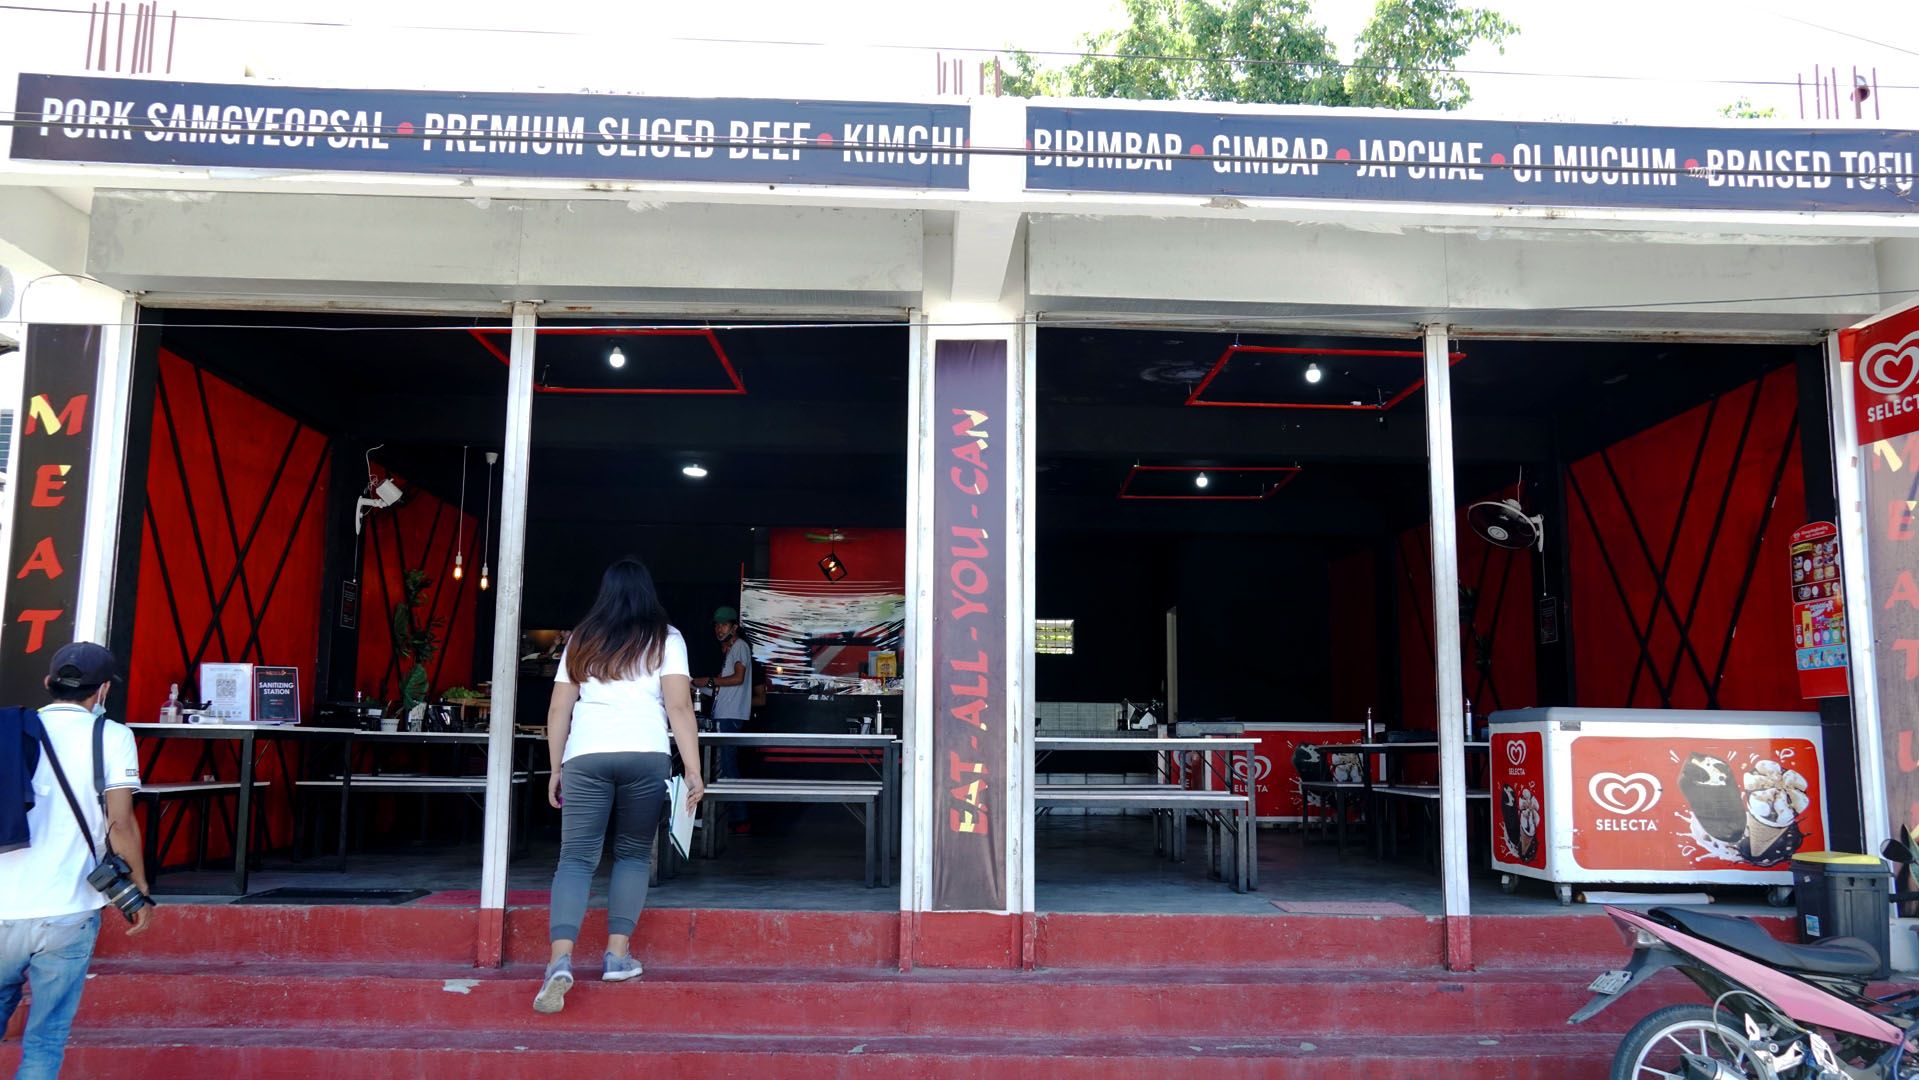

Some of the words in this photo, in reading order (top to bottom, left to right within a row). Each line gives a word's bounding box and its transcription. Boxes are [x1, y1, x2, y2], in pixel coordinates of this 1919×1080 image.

[40, 97, 133, 142] PORK
[146, 102, 390, 149] SAMGYEOPSAL
[423, 112, 584, 155] PREMIUM
[598, 116, 715, 160] SLICED
[728, 120, 811, 162] BEEF
[843, 123, 964, 166] KIMCHI
[1033, 128, 1183, 172] BIBIMBAP
[1212, 134, 1328, 176] GIMBAP
[1356, 138, 1484, 181] JAPCHAE
[1513, 143, 1541, 183] OI
[1554, 145, 1677, 186] MUCHIM
[1707, 149, 1832, 190] BRAISED
[1840, 151, 1913, 193] TOFU
[16, 393, 89, 654] MEAT
[1595, 818, 1657, 831] SELECTA
